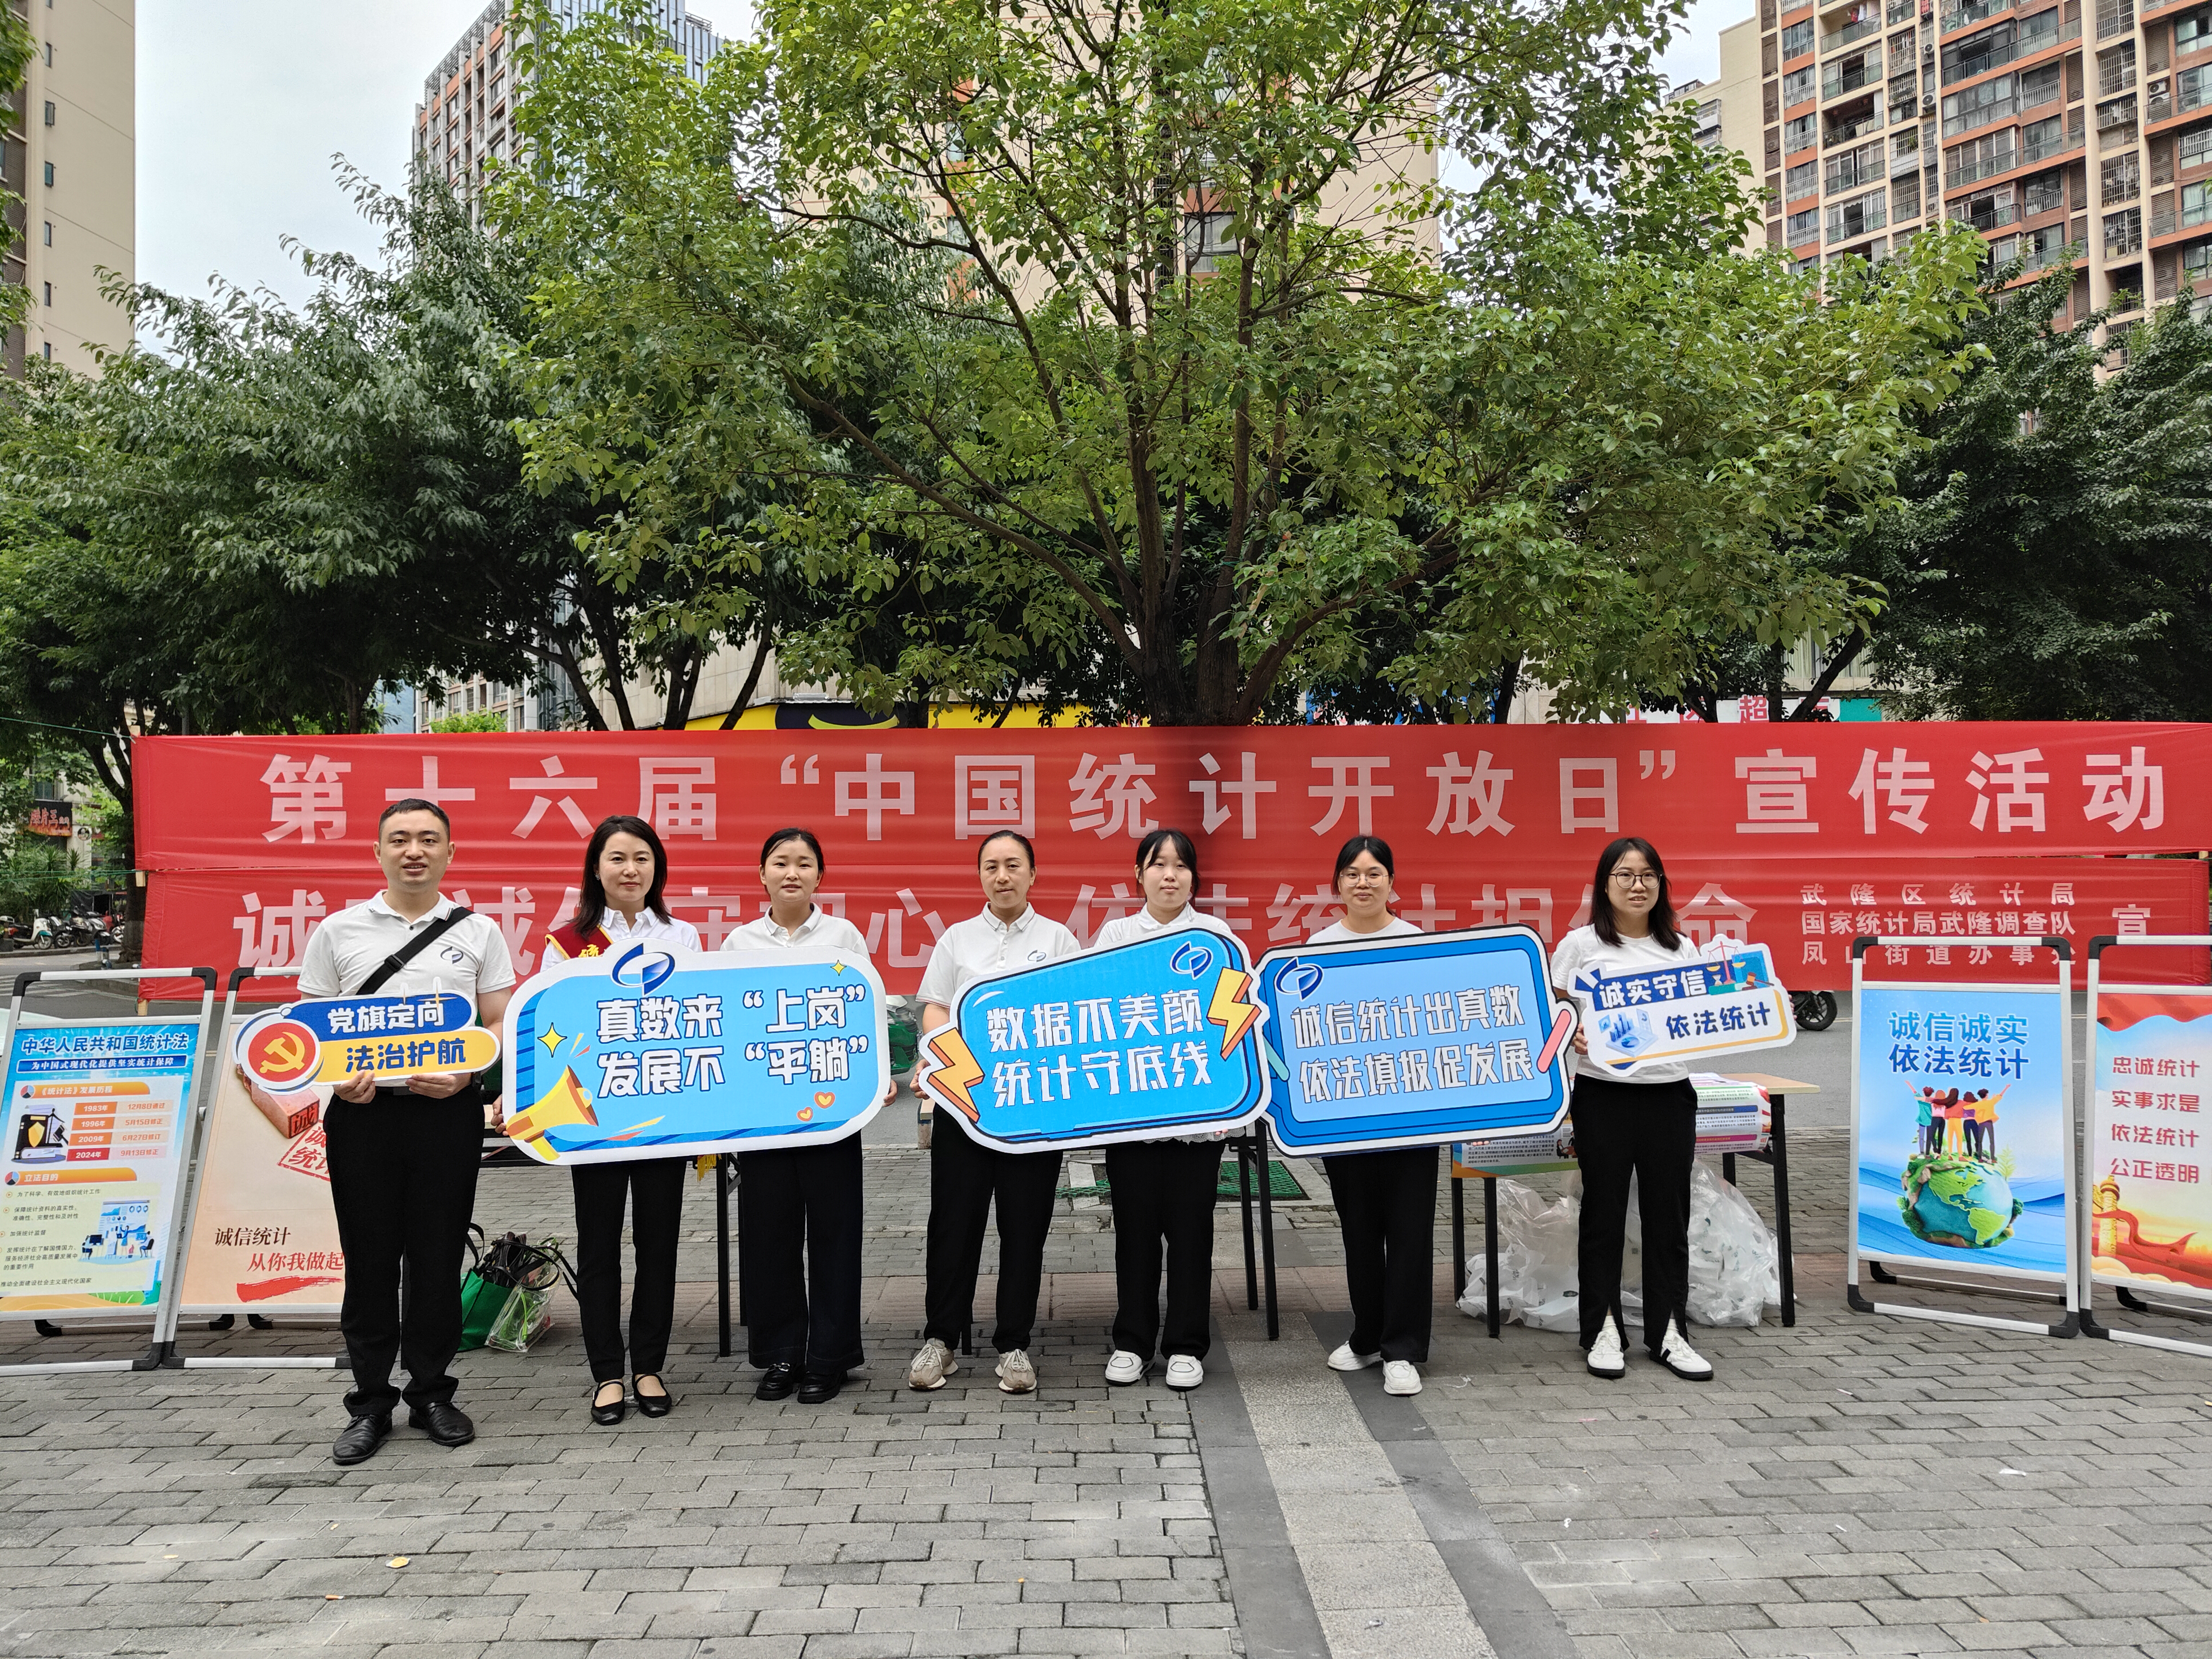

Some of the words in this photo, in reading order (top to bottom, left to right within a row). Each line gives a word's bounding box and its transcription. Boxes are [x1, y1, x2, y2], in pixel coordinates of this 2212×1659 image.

[1800, 882, 2075, 906] 武隆区统计局
[1802, 911, 2076, 935] 国家统计局武隆调查队
[2112, 904, 2150, 935] 宣
[1598, 969, 1707, 1009] 诚实守信
[327, 1002, 444, 1034] 党旗定向
[986, 989, 1204, 1053] 数据不美颜
[1291, 984, 1525, 1049] 诚信统计出真数
[1666, 1001, 1770, 1040] 依法统计
[1888, 1011, 2028, 1046] 诚信诚实
[22, 1033, 188, 1055] 中华人民共和国统计法
[346, 1038, 466, 1073] 法治护航
[31, 1057, 174, 1070] 为中国式现代化提供坚实统计保障
[992, 1040, 1212, 1108] 统计守底线
[1299, 1038, 1534, 1103] 依法填报促发展
[1889, 1043, 2029, 1080] 依法统计
[2112, 1056, 2201, 1078] 忠诚统计
[41, 1085, 113, 1096] 《统计法》发展历程
[2112, 1090, 2200, 1113] 实事求是
[2112, 1123, 2200, 1148] 依法统计
[24, 1173, 58, 1182] 立法目的
[2110, 1158, 2199, 1184] 公正透明
[214, 1226, 291, 1246] 诚信统计
[246, 1251, 345, 1272] 从你我做起
